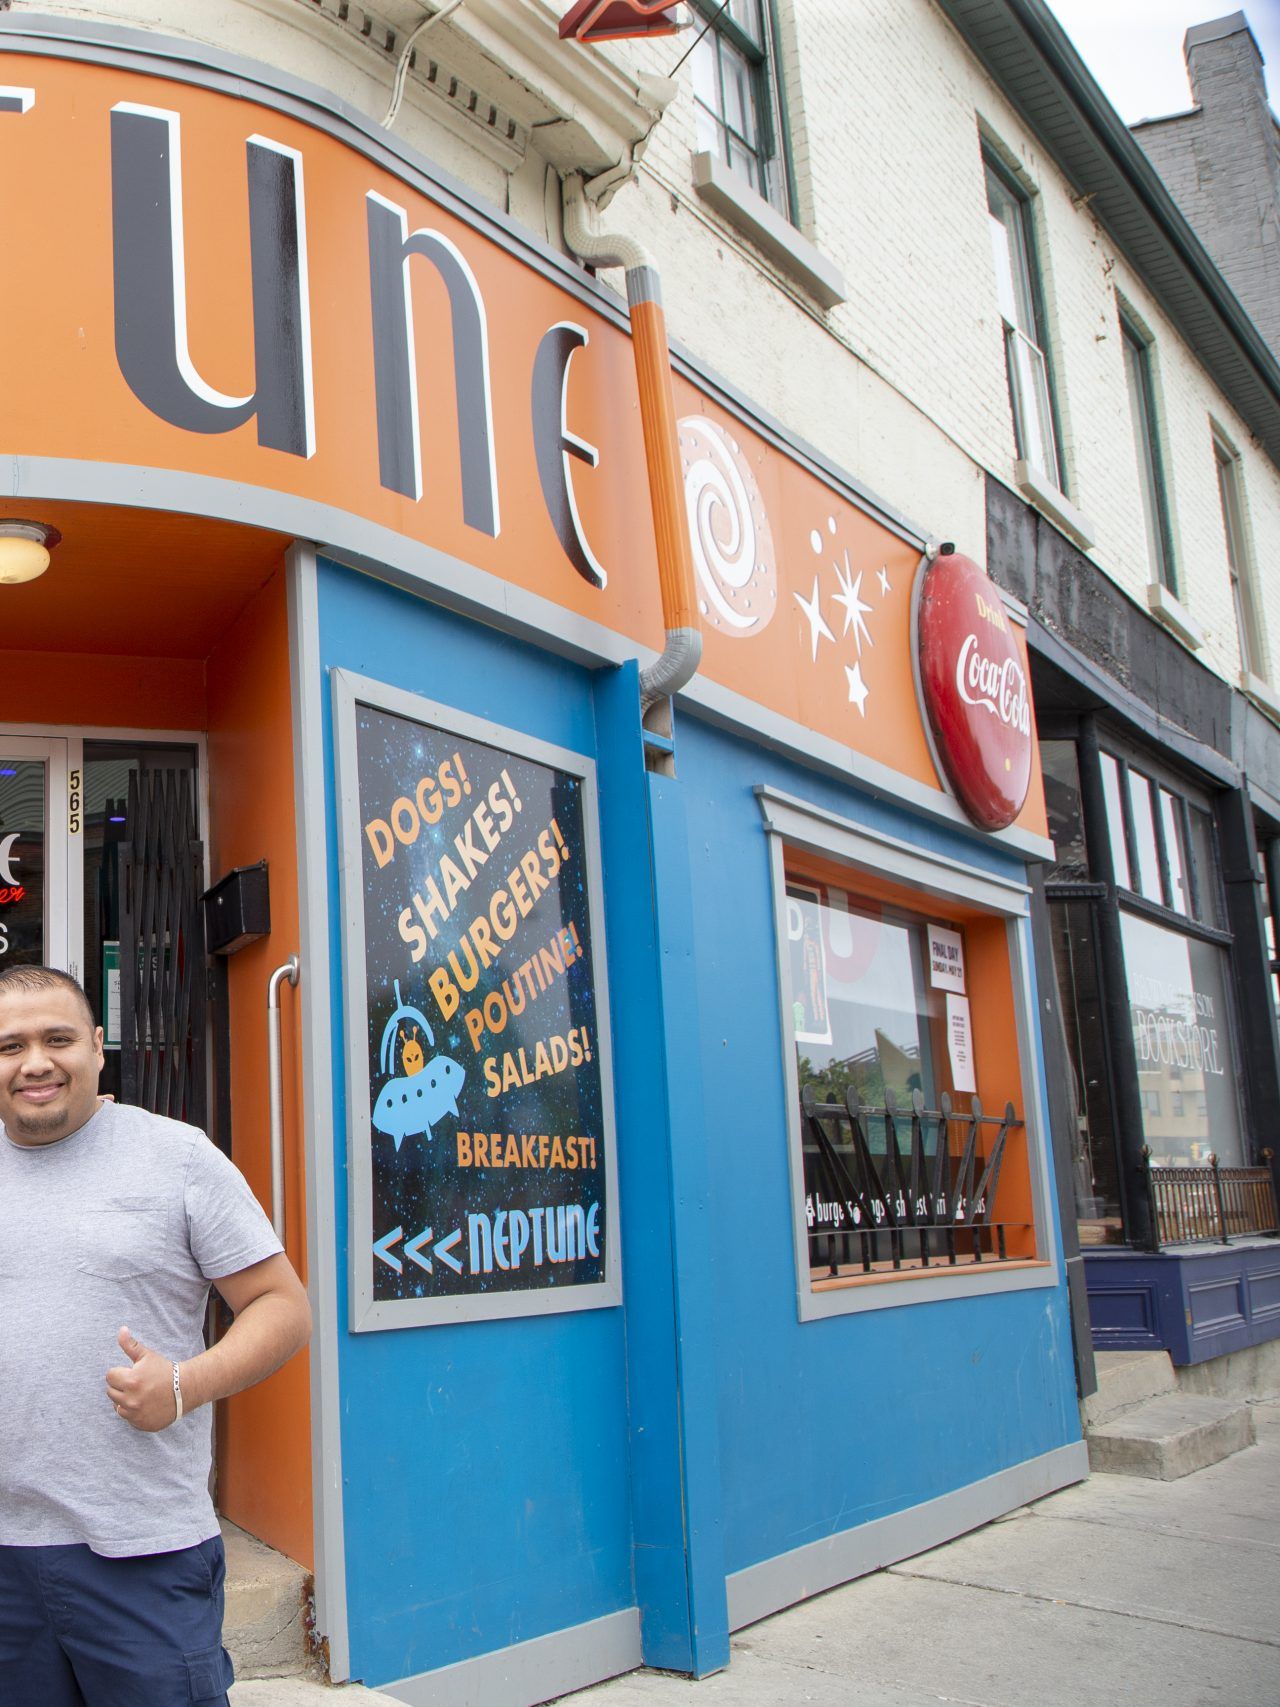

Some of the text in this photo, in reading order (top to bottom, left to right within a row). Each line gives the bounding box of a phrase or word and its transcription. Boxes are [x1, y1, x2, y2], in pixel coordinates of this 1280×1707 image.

[975, 593, 1007, 632] Drink
[364, 752, 472, 869] DOGS!
[397, 769, 523, 964] SHAKES!
[428, 818, 569, 1022] BURGERS!
[932, 941, 959, 962] FINAL DAY
[464, 921, 584, 1053] POUTINE!
[483, 1026, 591, 1098] SALADS!
[1136, 1009, 1224, 1075] BOOKSTORE
[457, 1132, 596, 1169] BREAKFAST!
